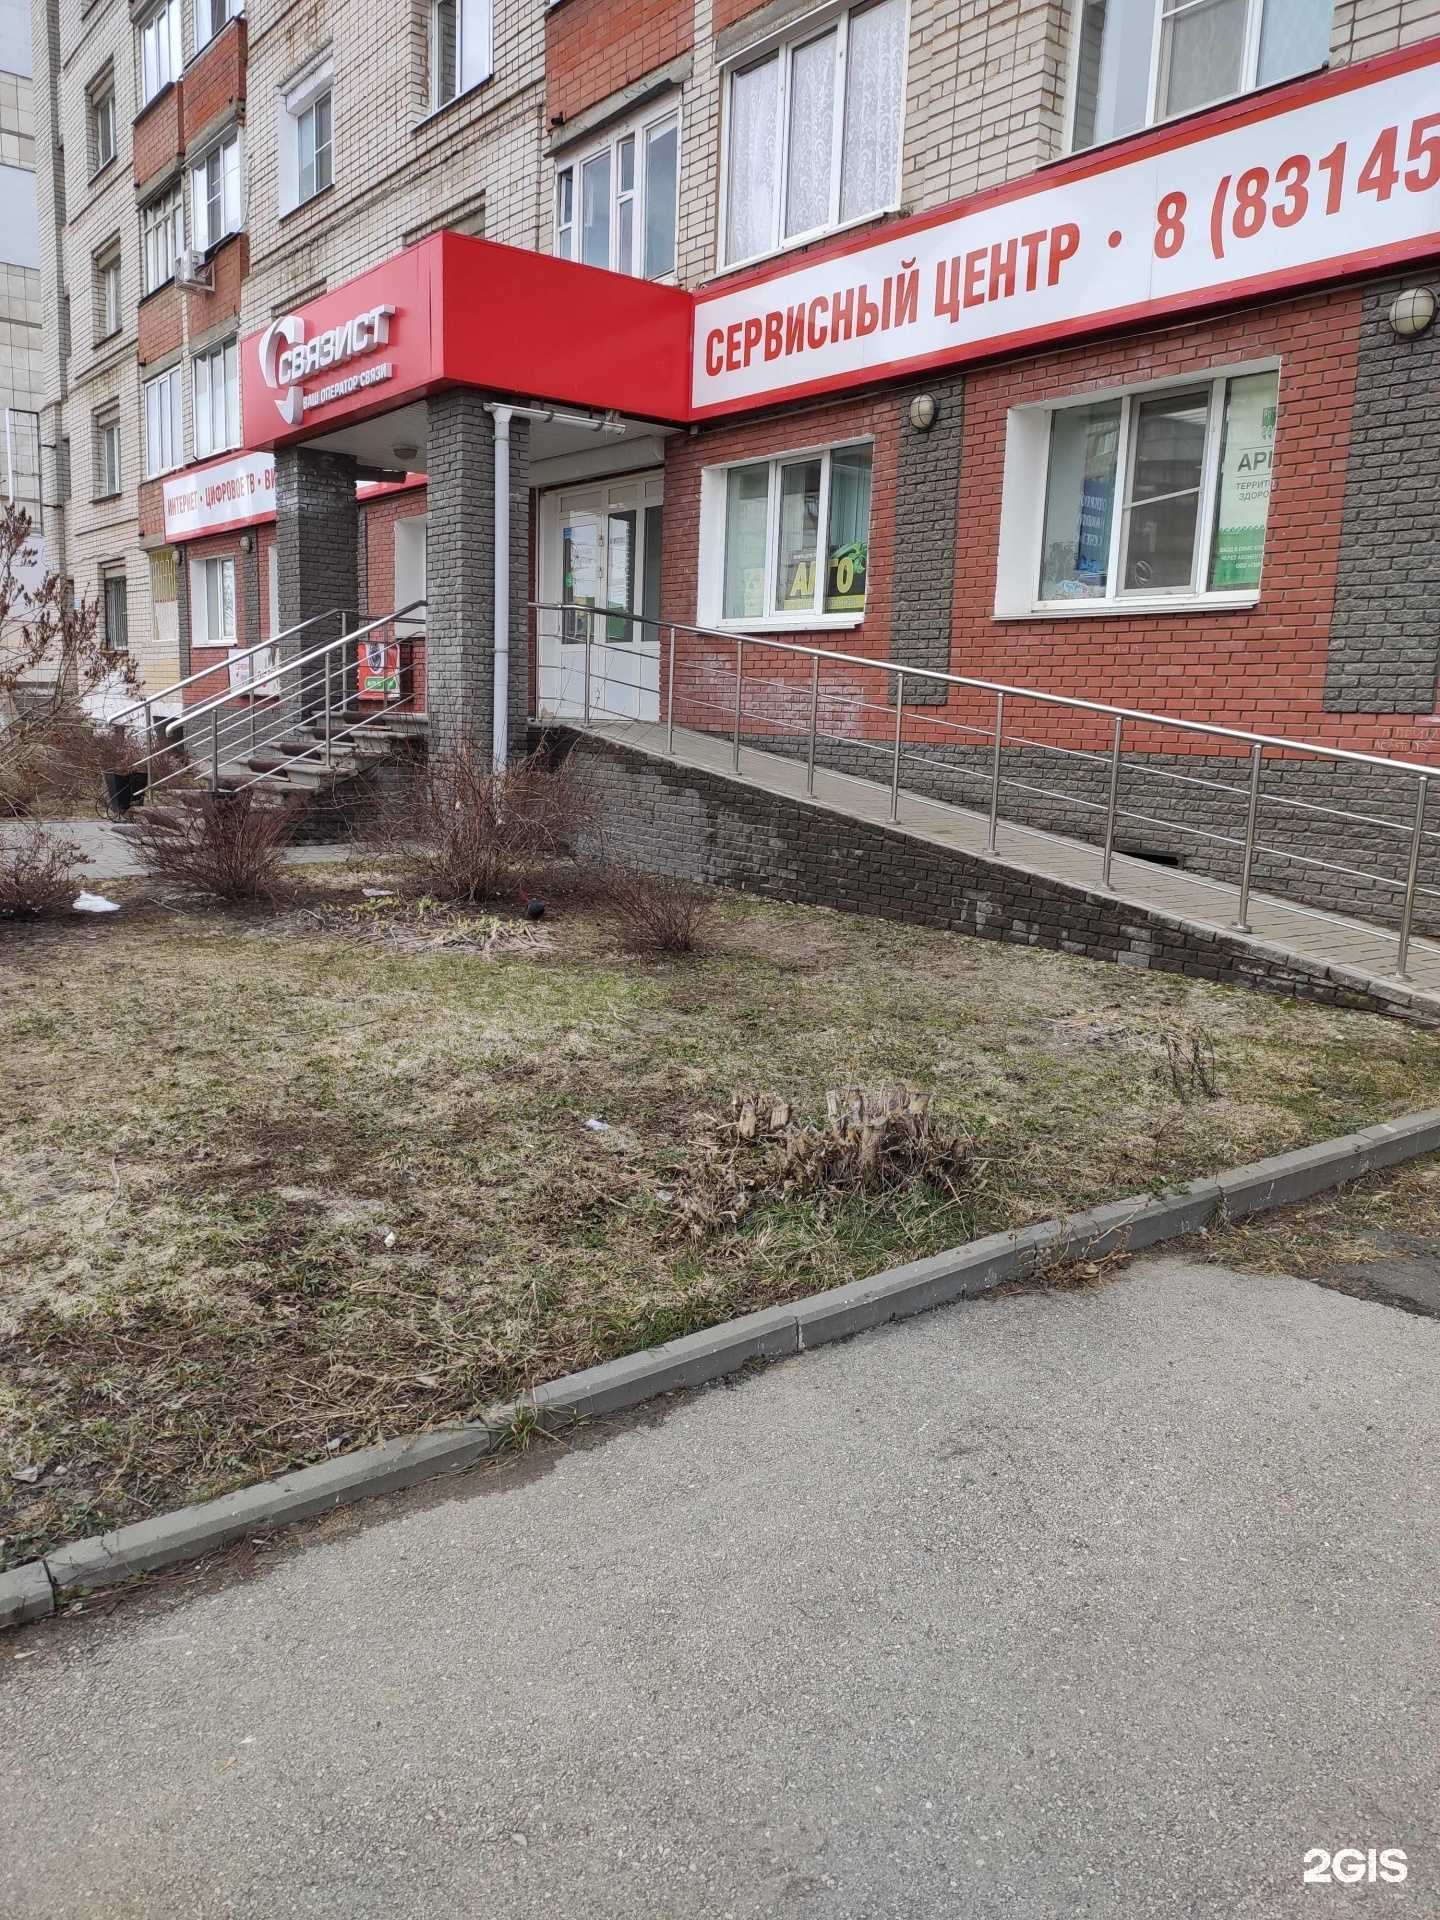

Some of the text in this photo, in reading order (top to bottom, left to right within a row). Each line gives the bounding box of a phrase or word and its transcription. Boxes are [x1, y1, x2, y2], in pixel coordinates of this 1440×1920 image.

[706, 112, 1440, 377] СЕРВИСНЫЙ ЦЕНТР 8 (83145
[278, 304, 395, 386] СВЯЗИСТ
[303, 363, 391, 410] ВАШ ОПЕРАТОР СВЯЗИ
[168, 491, 197, 516] ИНТЕРНЕТ
[205, 477, 244, 509] ЦИФРОВОЕ
[245, 473, 255, 494] ТВ
